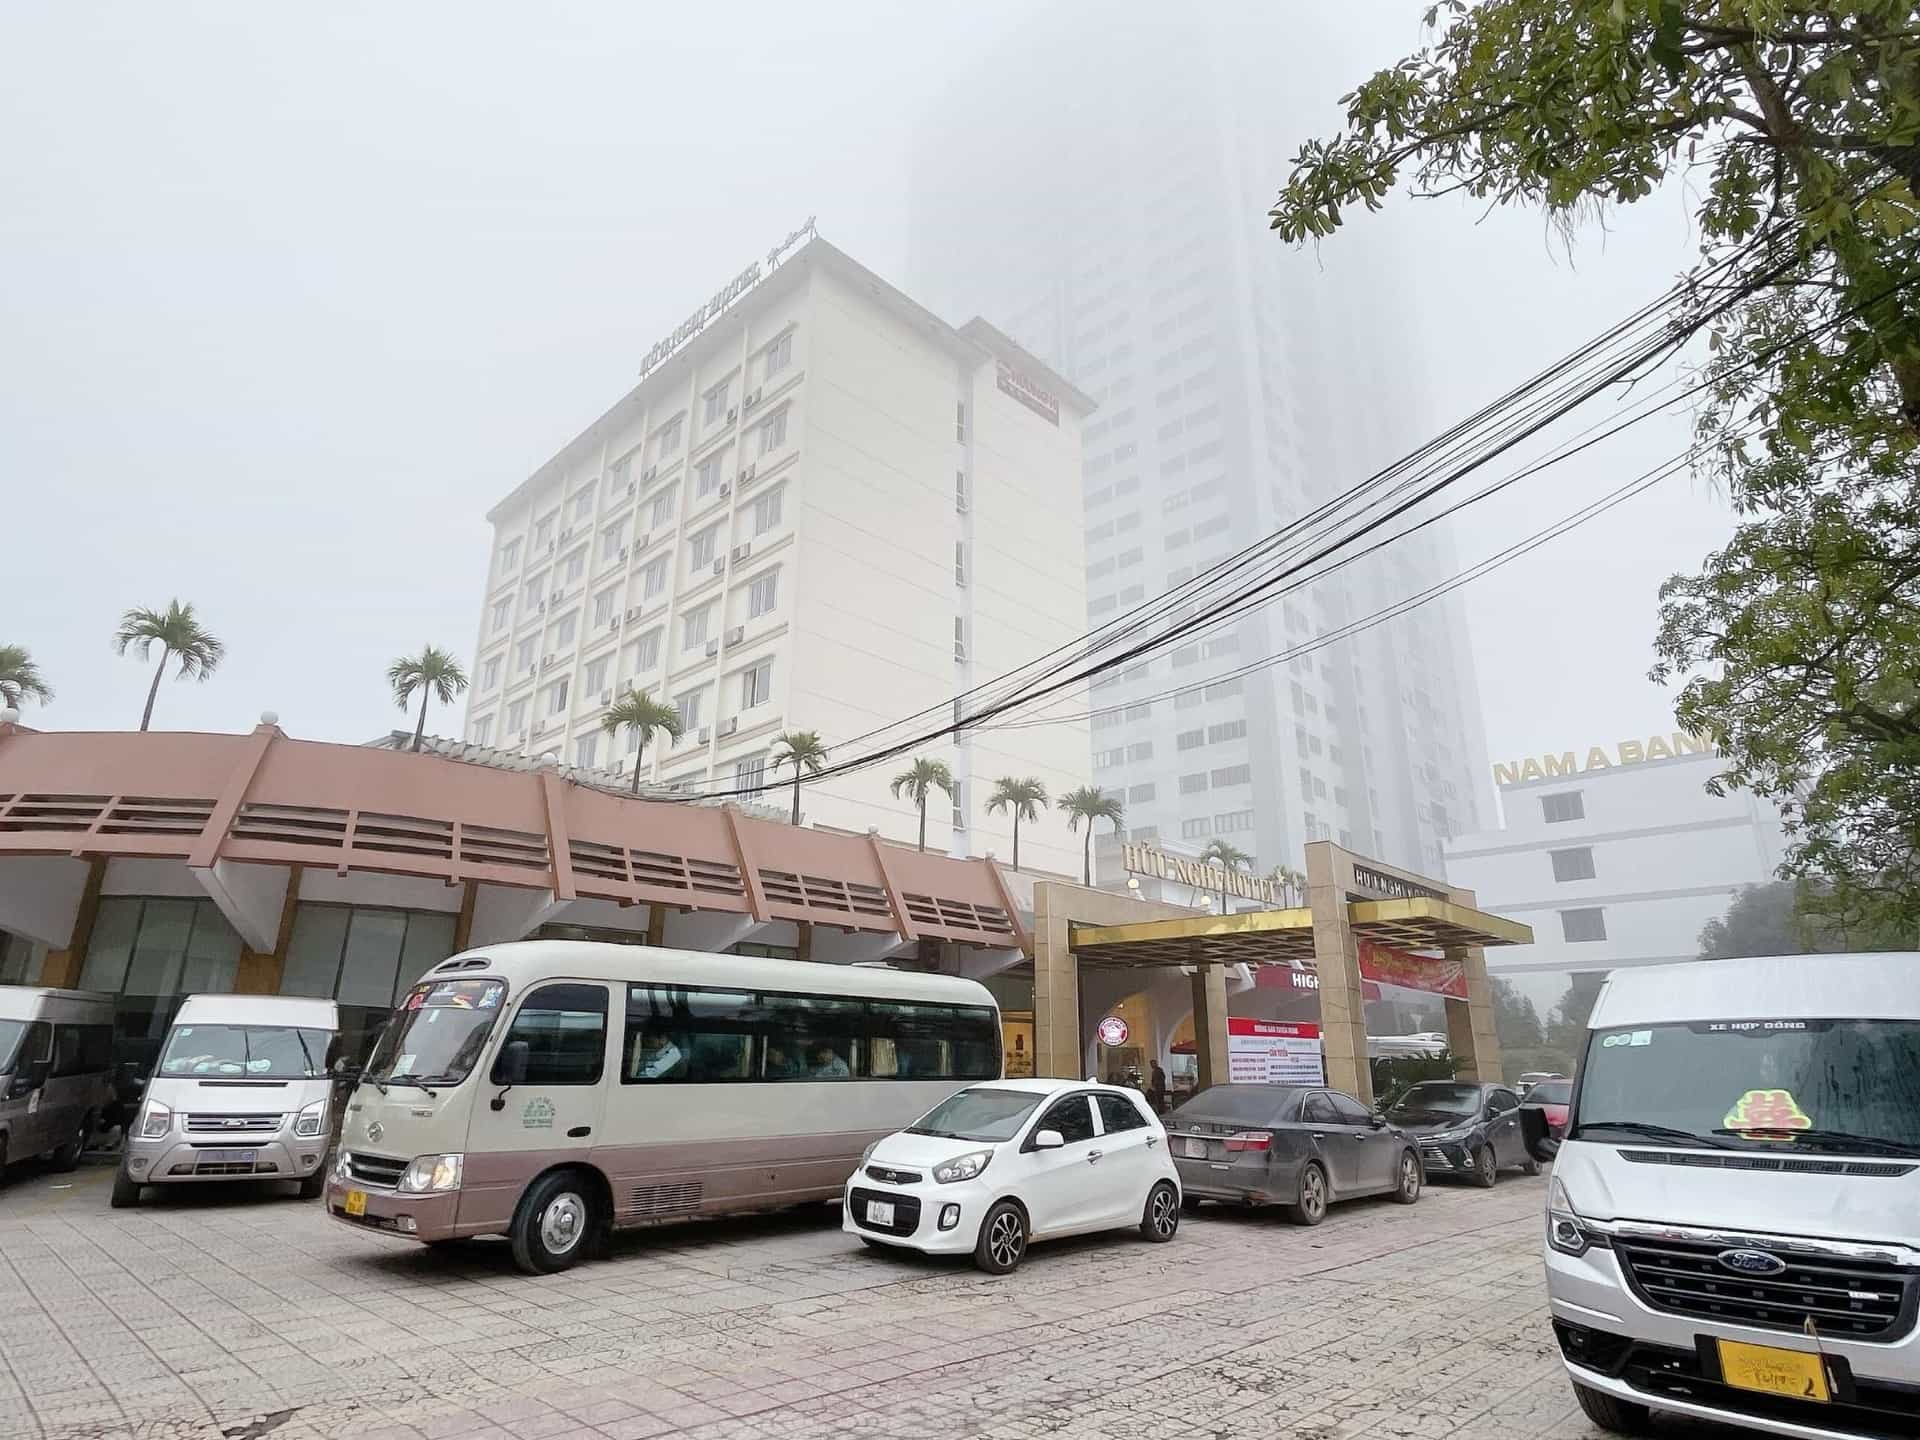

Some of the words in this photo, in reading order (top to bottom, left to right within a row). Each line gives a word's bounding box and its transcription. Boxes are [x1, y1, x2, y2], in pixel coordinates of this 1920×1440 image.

[1493, 751, 1577, 785] NAM
[1585, 746, 1614, 770] A
[1708, 1023, 1728, 1031] XE
[1731, 1253, 1770, 1271] Ford
